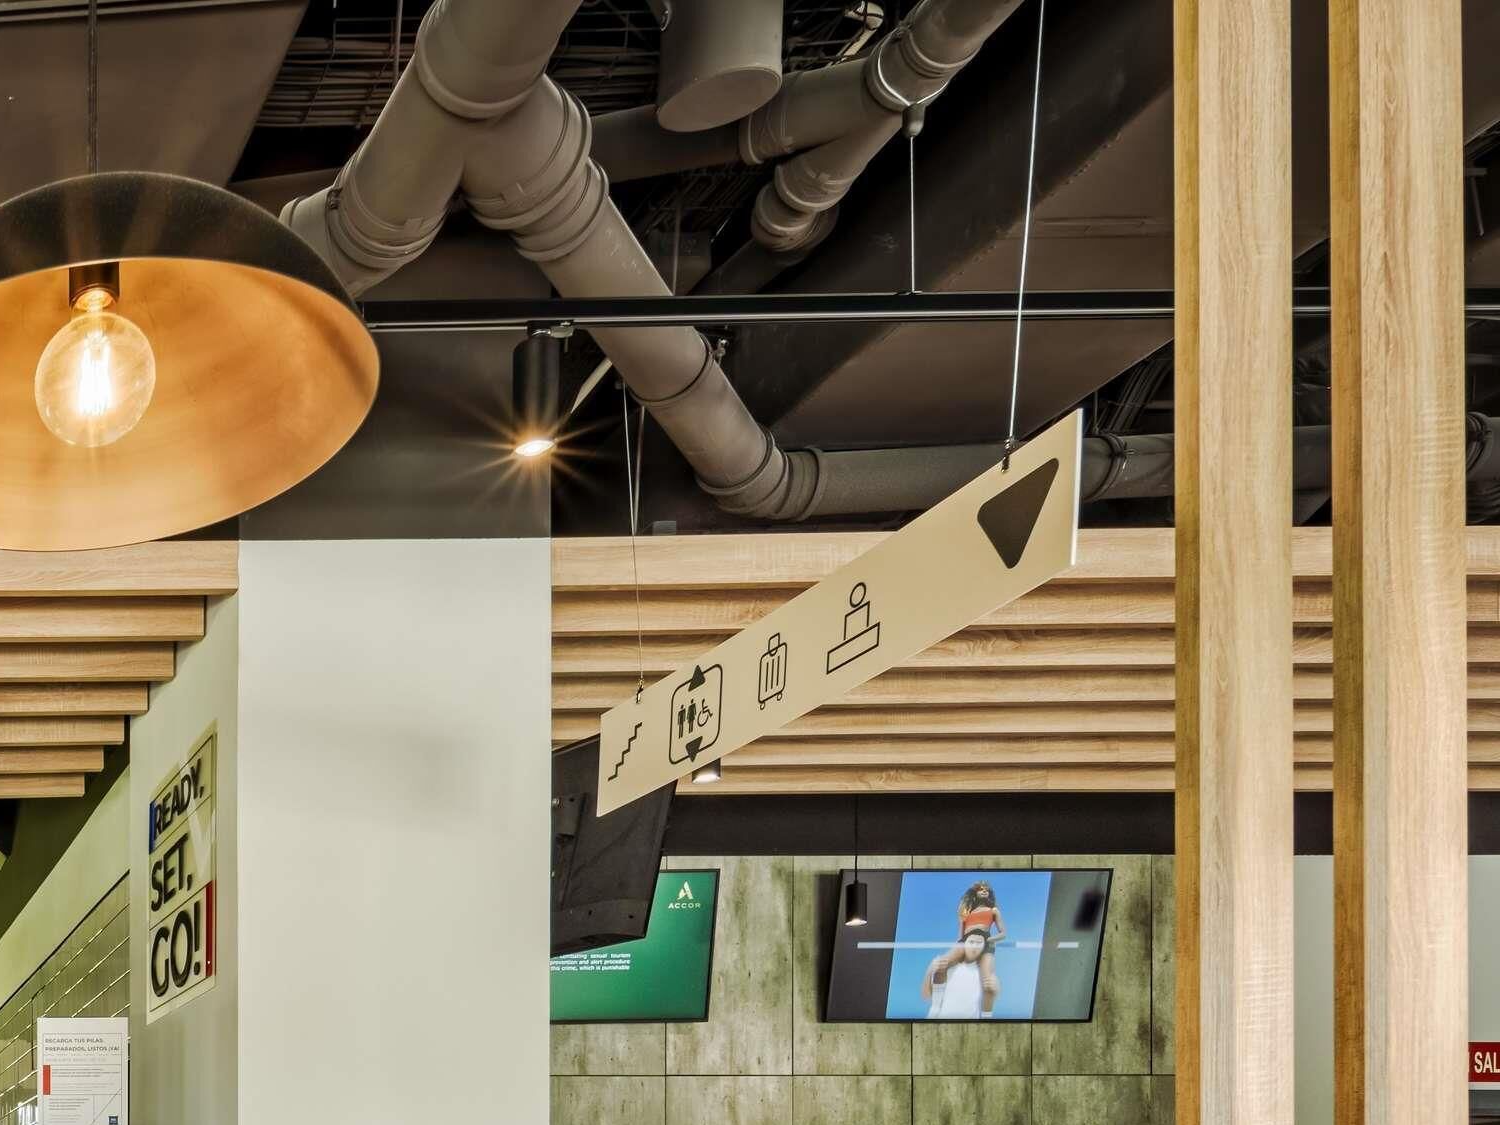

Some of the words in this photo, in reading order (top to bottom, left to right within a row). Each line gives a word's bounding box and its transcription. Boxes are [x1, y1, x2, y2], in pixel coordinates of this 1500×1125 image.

[154, 758, 205, 836] READY,
[151, 832, 193, 912] SET,
[151, 901, 201, 997] GO!
